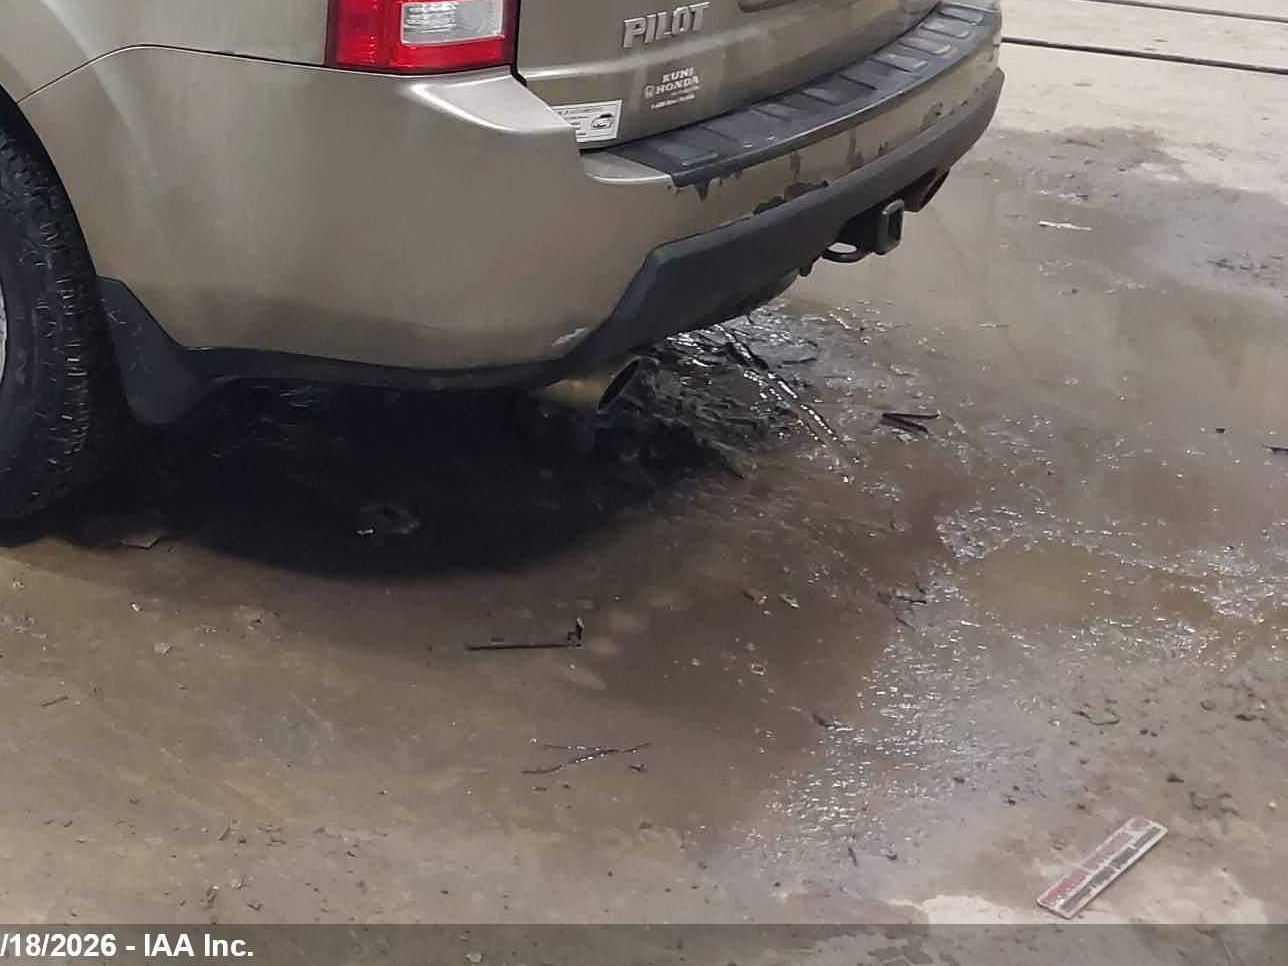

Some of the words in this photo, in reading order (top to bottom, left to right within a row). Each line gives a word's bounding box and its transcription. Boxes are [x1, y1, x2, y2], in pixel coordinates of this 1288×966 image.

[622, 1, 711, 49] PILOT
[662, 67, 694, 83] KUNI
[655, 76, 699, 94] HONDA
